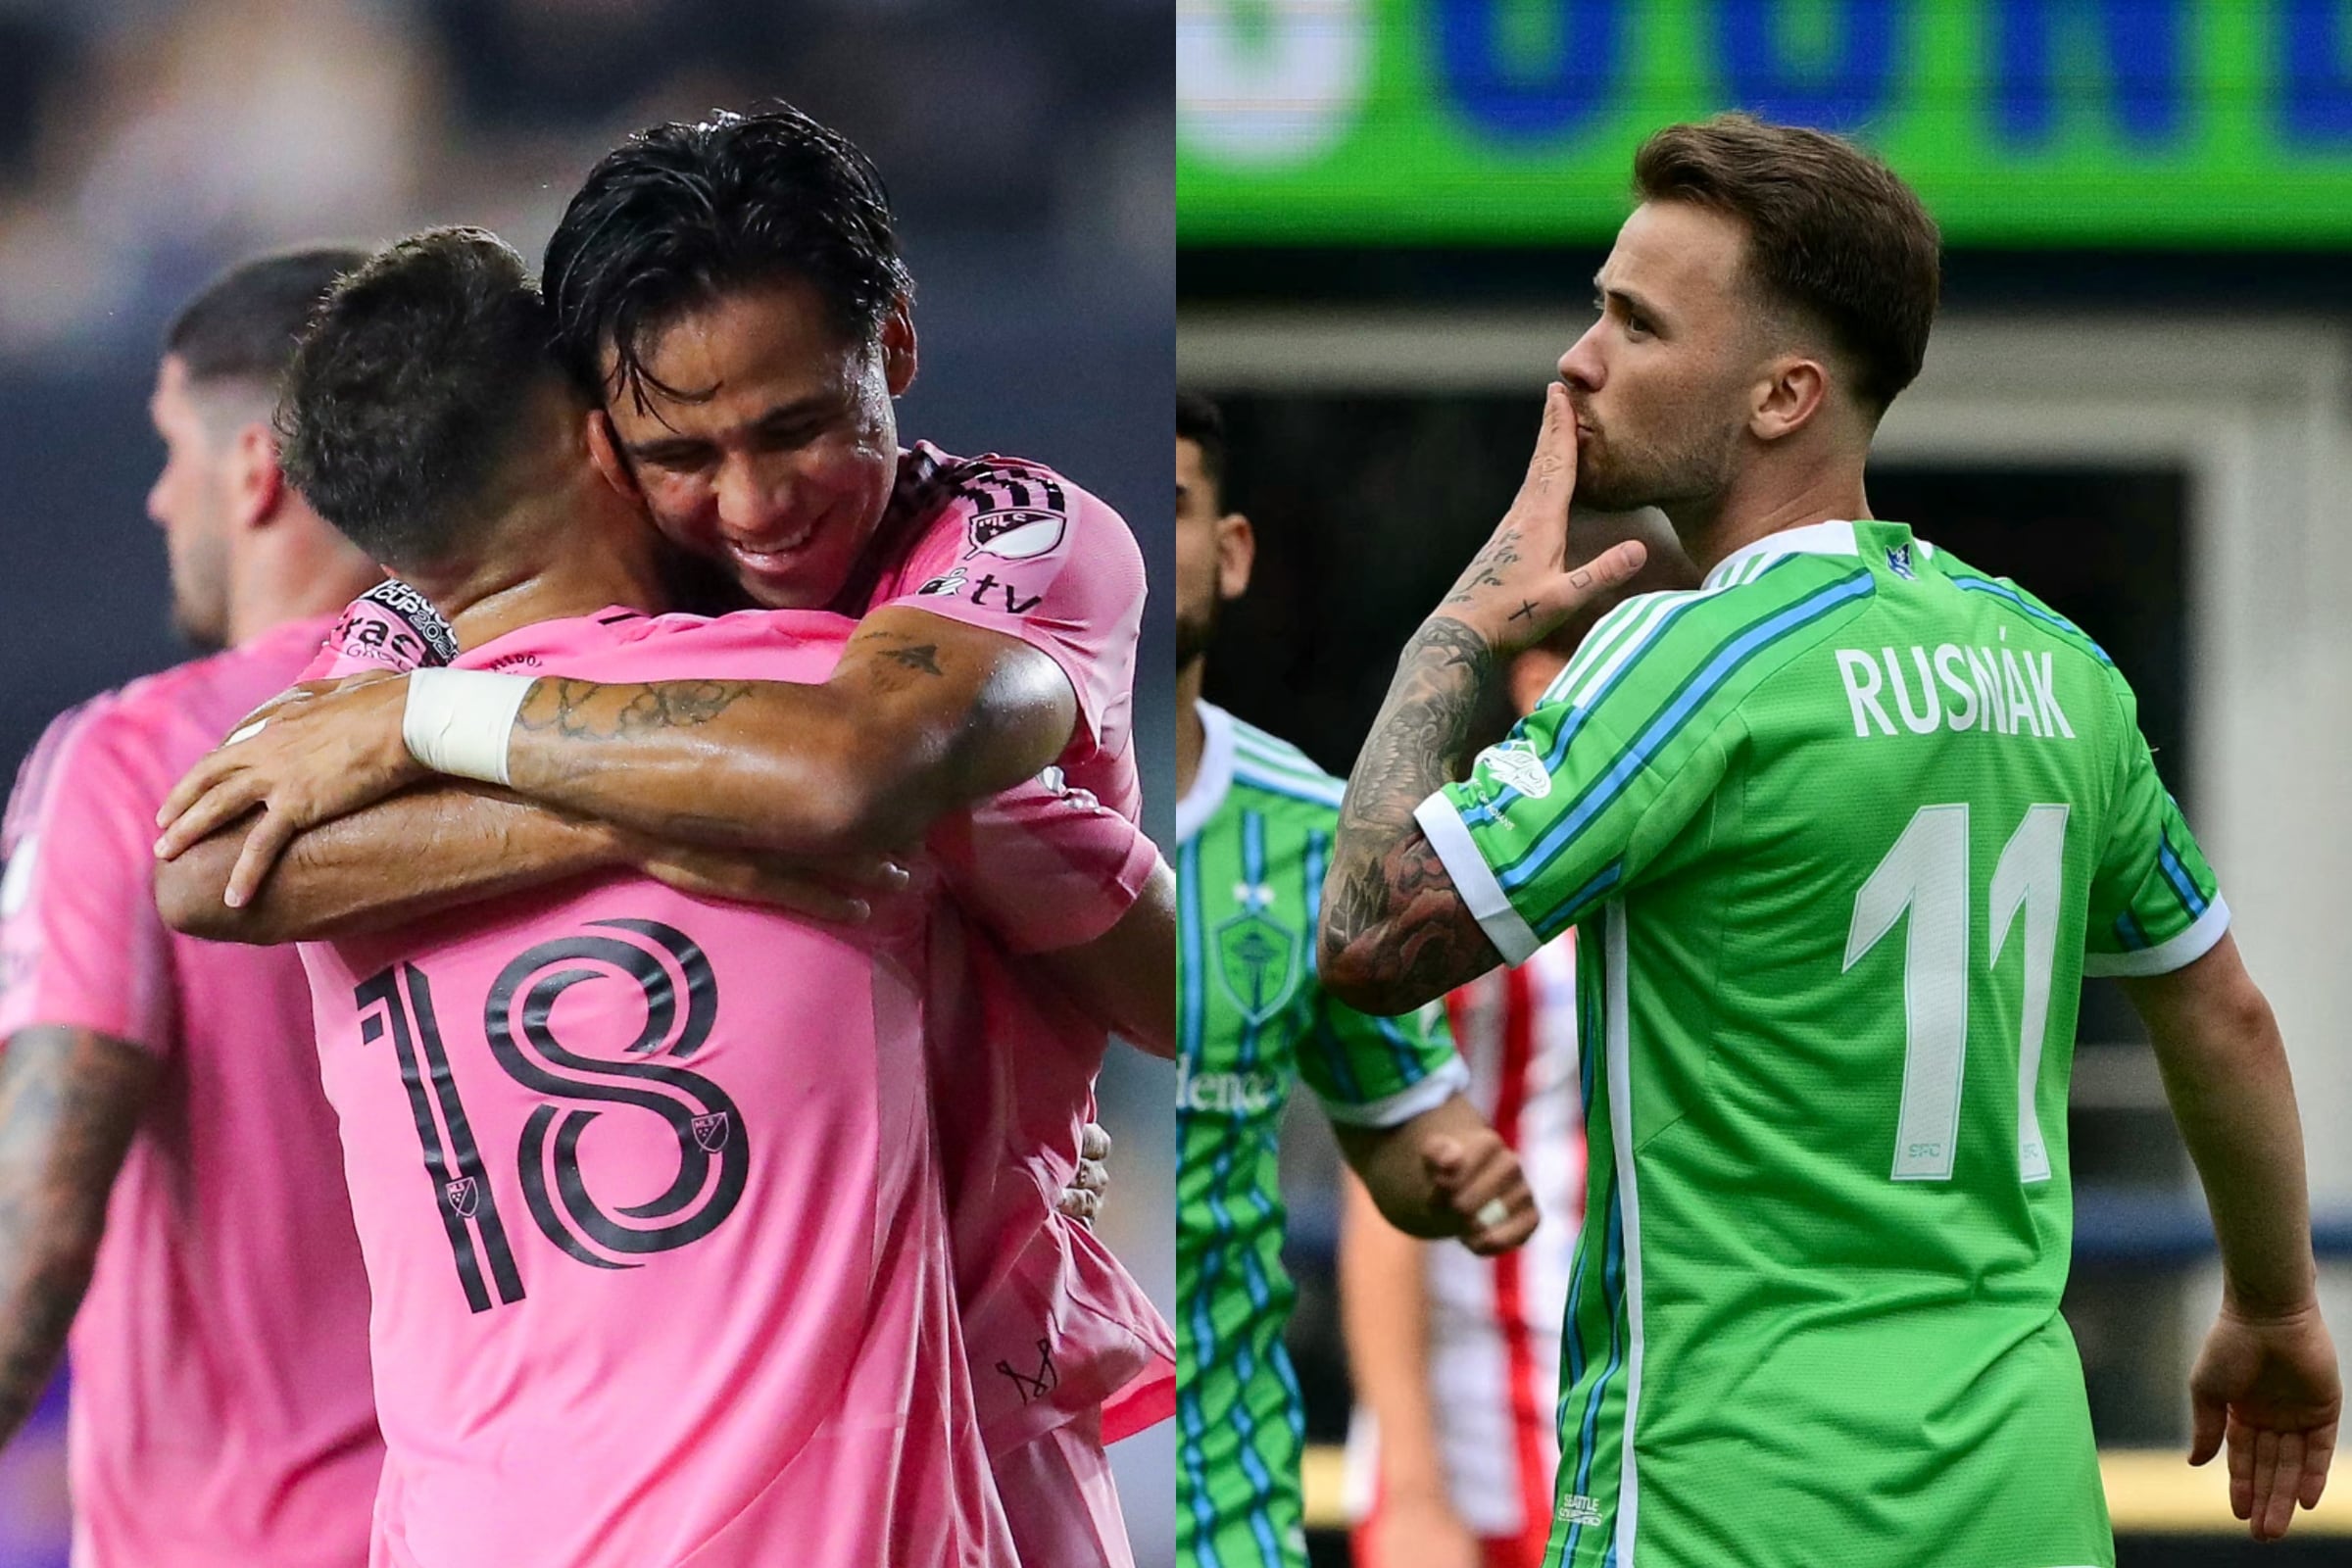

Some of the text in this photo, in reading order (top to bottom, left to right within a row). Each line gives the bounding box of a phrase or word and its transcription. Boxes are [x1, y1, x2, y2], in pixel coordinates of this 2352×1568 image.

[374, 588, 418, 614] CUP
[970, 574, 1042, 613] tv
[1835, 626, 2077, 739] RUSNÁK
[1841, 803, 2071, 1183] 11
[354, 917, 750, 1313] 18
[1562, 1494, 1600, 1512] SEATTLE
